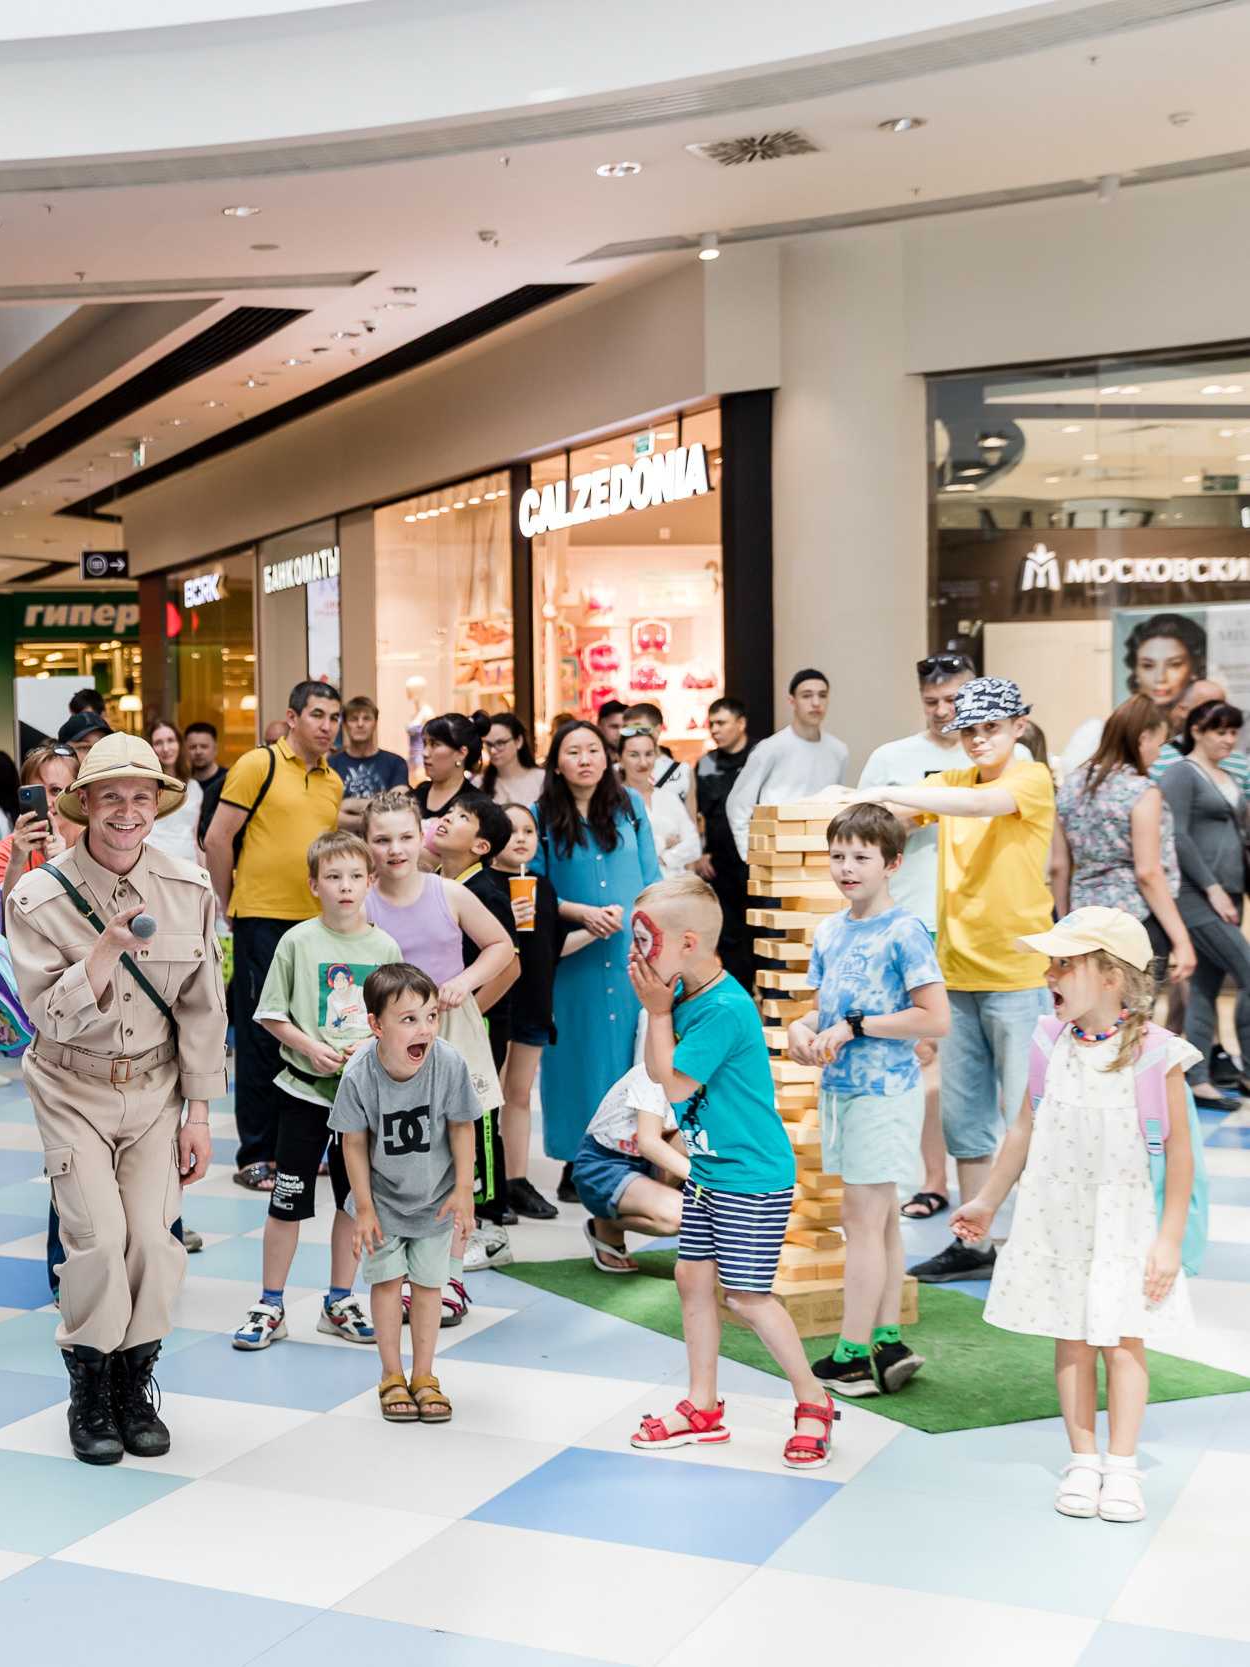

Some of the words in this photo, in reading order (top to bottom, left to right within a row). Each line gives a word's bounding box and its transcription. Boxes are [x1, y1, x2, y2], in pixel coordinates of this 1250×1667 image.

[519, 442, 709, 538] CALZEDONIA
[184, 572, 221, 608] BORK
[263, 546, 340, 594] БАНКОМАТЫ
